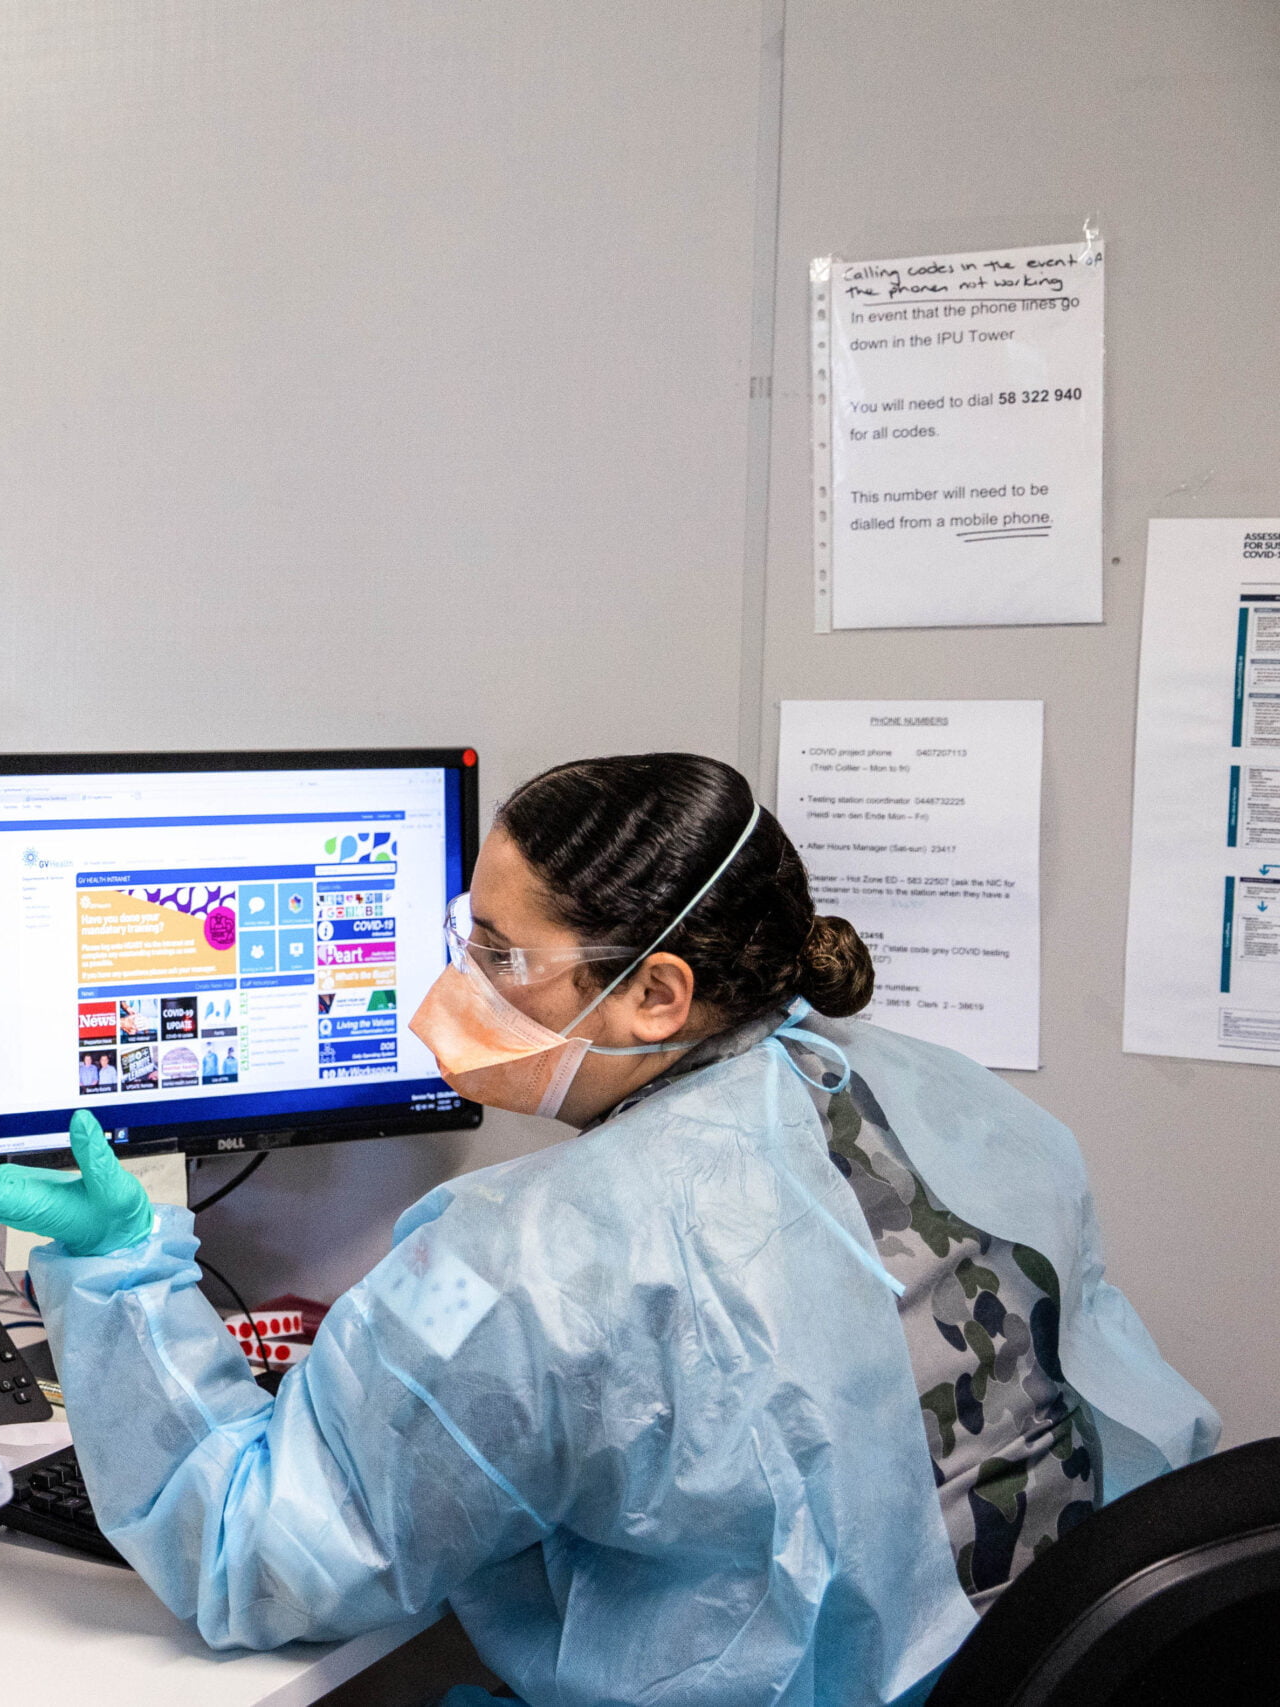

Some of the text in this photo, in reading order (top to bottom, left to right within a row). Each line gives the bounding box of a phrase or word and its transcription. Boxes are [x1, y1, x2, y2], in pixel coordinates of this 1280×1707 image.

[844, 264, 901, 284] Calling
[907, 262, 955, 277] codes
[961, 261, 978, 272] in
[983, 256, 1016, 272] the
[1026, 255, 1078, 270] event
[844, 285, 881, 299] the
[958, 277, 988, 291] not
[993, 274, 1064, 293] working
[850, 296, 1081, 324] In event that the phone lines go
[850, 329, 1016, 351] down in the IPU Tower
[850, 388, 1082, 414] You will need to dial 58 322 940
[850, 424, 940, 441] for all codes.
[850, 482, 1049, 504] This number will need to be
[850, 511, 1055, 531] dialled from a mobile phone.
[1244, 532, 1280, 541] ASSESS
[1243, 541, 1263, 550] FOR
[870, 716, 949, 727] PHONE NUMBERS
[809, 748, 837, 757] COVID
[838, 748, 866, 759] project
[867, 748, 893, 759] phone
[870, 764, 888, 773] Mon
[807, 795, 837, 806] Testing
[838, 796, 865, 805] station
[866, 796, 910, 806] coordinator
[888, 812, 906, 821] Mon
[827, 843, 850, 852] Hours
[852, 843, 888, 854] Manager
[163, 1008, 194, 1018] COVID-19
[79, 1013, 116, 1028] News
[166, 1021, 193, 1031] UPDATE
[217, 1137, 245, 1151] DELL
